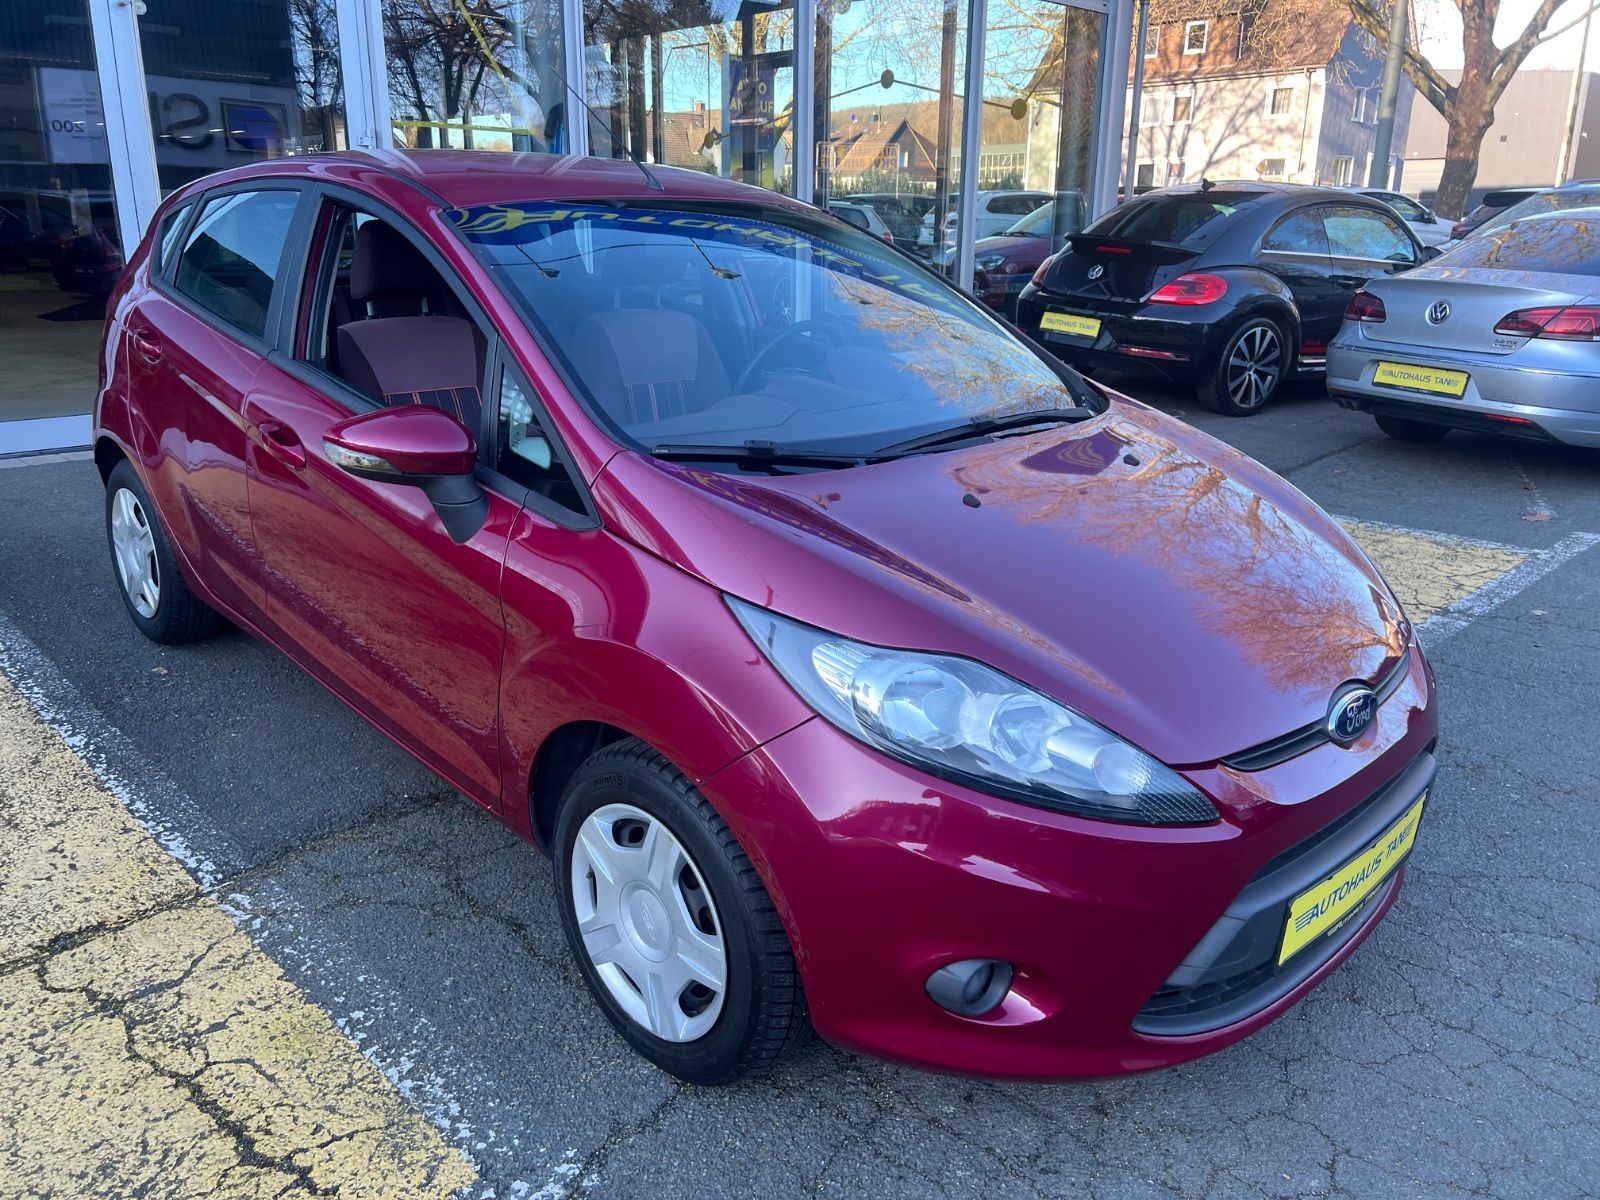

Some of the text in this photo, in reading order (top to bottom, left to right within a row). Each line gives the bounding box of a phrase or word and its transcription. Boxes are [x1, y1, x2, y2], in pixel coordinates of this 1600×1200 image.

[736, 79, 767, 95] AO
[729, 97, 774, 113] ANUF
[1387, 370, 1451, 386] AUTOHAUS TAN
[1346, 698, 1371, 732] Ford
[1308, 851, 1384, 922] AUTOHAUS
